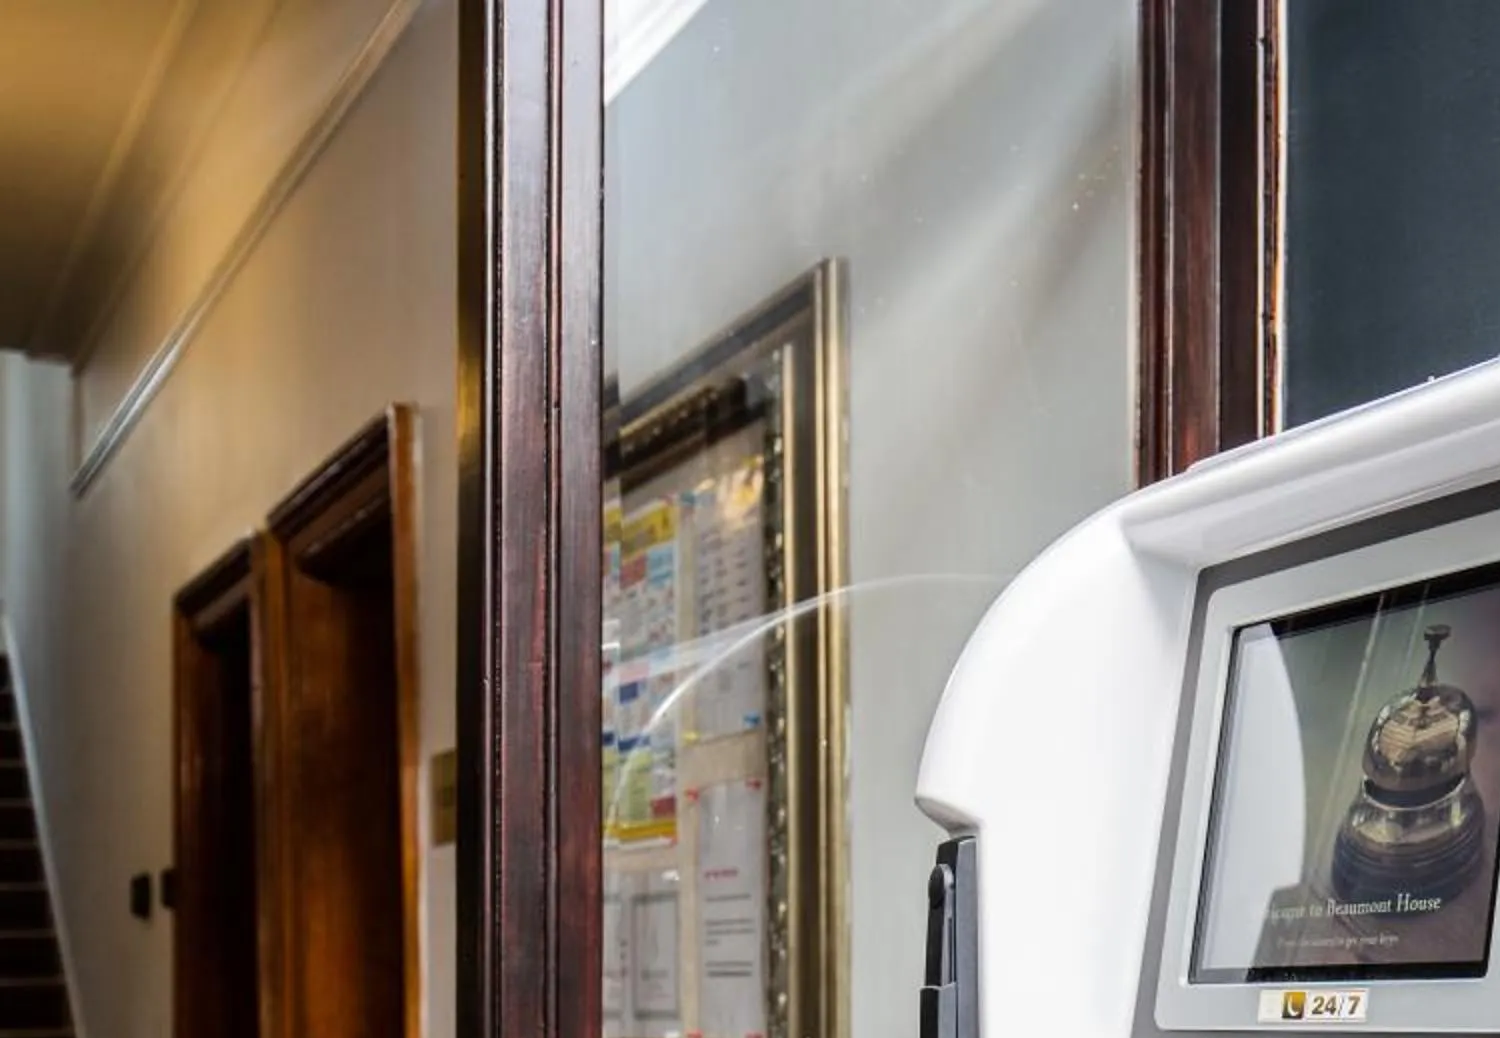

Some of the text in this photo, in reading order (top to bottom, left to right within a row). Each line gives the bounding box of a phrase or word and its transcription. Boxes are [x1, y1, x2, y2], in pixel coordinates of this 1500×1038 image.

[1327, 898, 1391, 917] Beaumont
[1396, 893, 1441, 913] House
[1311, 995, 1361, 1016] 24/7
